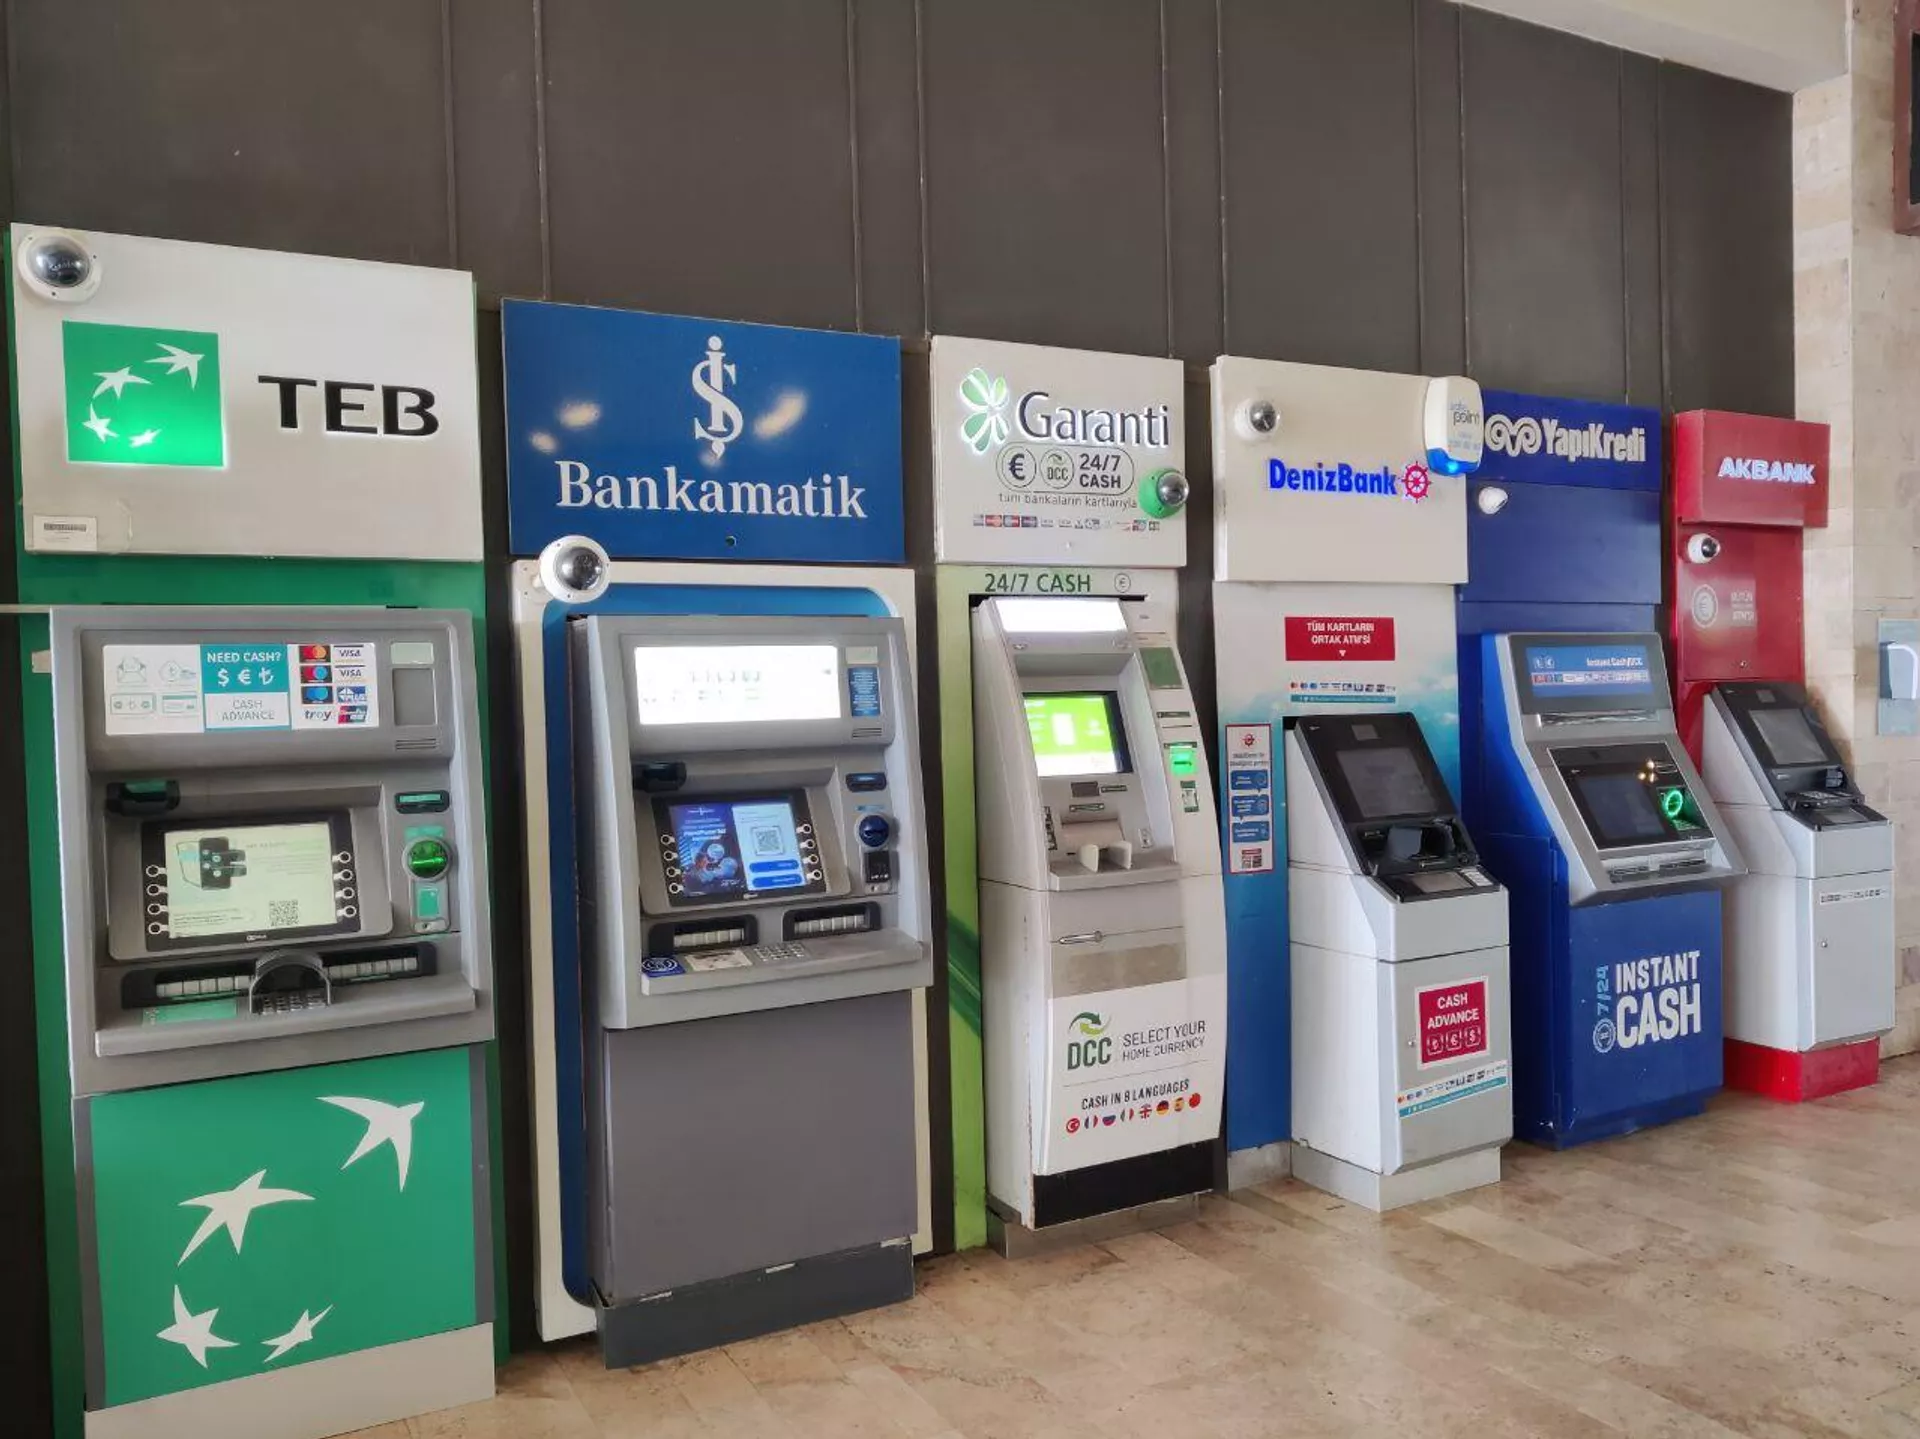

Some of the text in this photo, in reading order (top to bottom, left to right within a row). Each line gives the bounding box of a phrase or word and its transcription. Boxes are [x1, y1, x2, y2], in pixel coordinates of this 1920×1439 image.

[258, 375, 439, 437] TEB
[1018, 391, 1169, 447] Garanti
[1541, 418, 1647, 462] YapıKredi
[1046, 466, 1069, 481] DCC
[1079, 453, 1121, 472] 24/7
[1268, 458, 1397, 495] DenizBank
[1718, 456, 1816, 485] AKBANK
[554, 460, 867, 519] Bankamatik
[1079, 474, 1121, 489] CASH
[984, 573, 1028, 593] 24/7
[1037, 573, 1091, 593] CASH
[206, 652, 281, 663] NEED CASH?
[217, 668, 230, 687] $
[238, 669, 251, 685] €
[340, 669, 362, 677] VISA
[221, 711, 275, 722] ADVANCE
[233, 699, 263, 710] CASH
[305, 710, 332, 722] troy
[1615, 950, 1700, 995] INSTANT
[1437, 992, 1468, 1010] CASH
[1427, 1007, 1480, 1030] ADVANCE
[1616, 982, 1702, 1049] CASH
[1122, 1020, 1207, 1048] SELECT YOUR
[1067, 1037, 1112, 1071] DCC
[1122, 1036, 1206, 1062] HOME CURRENCY
[1081, 1094, 1109, 1110] CASH
[1111, 1092, 1121, 1104] IN
[1132, 1078, 1190, 1101] LANGUAGES
